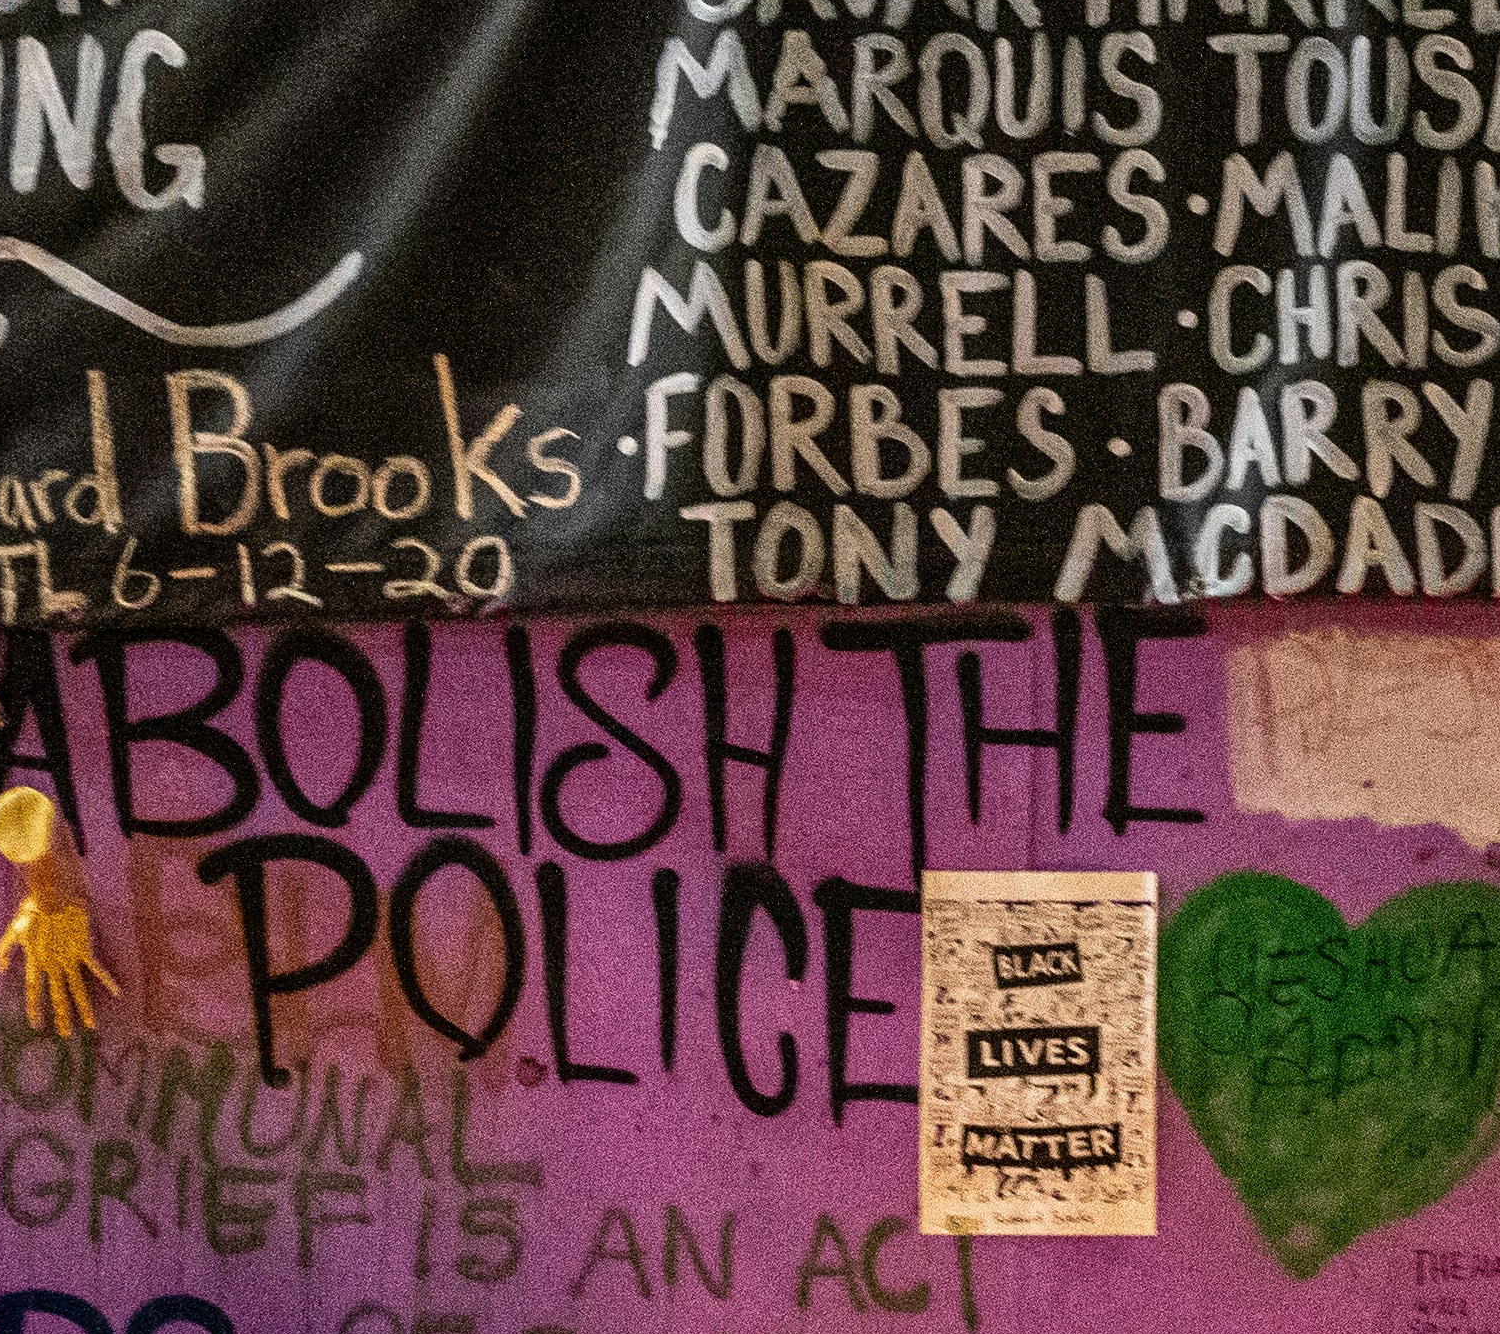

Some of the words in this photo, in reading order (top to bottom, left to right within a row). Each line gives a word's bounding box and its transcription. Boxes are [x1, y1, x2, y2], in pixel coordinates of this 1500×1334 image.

[648, 28, 1164, 150] MARQUIS
[673, 142, 1168, 264] CAZARES
[628, 259, 1157, 374] MURRELL
[644, 372, 1075, 500] FORBES
[1157, 378, 1493, 500] BARRY
[679, 499, 997, 604] TONY
[820, 611, 1206, 879] THE
[198, 833, 921, 1126] POLICE
[999, 953, 1078, 978] BLACK
[981, 1037, 1088, 1066] LIVES
[967, 1130, 1114, 1161] MATTER
[418, 1176, 523, 1283] IS
[572, 1207, 733, 1300] AN
